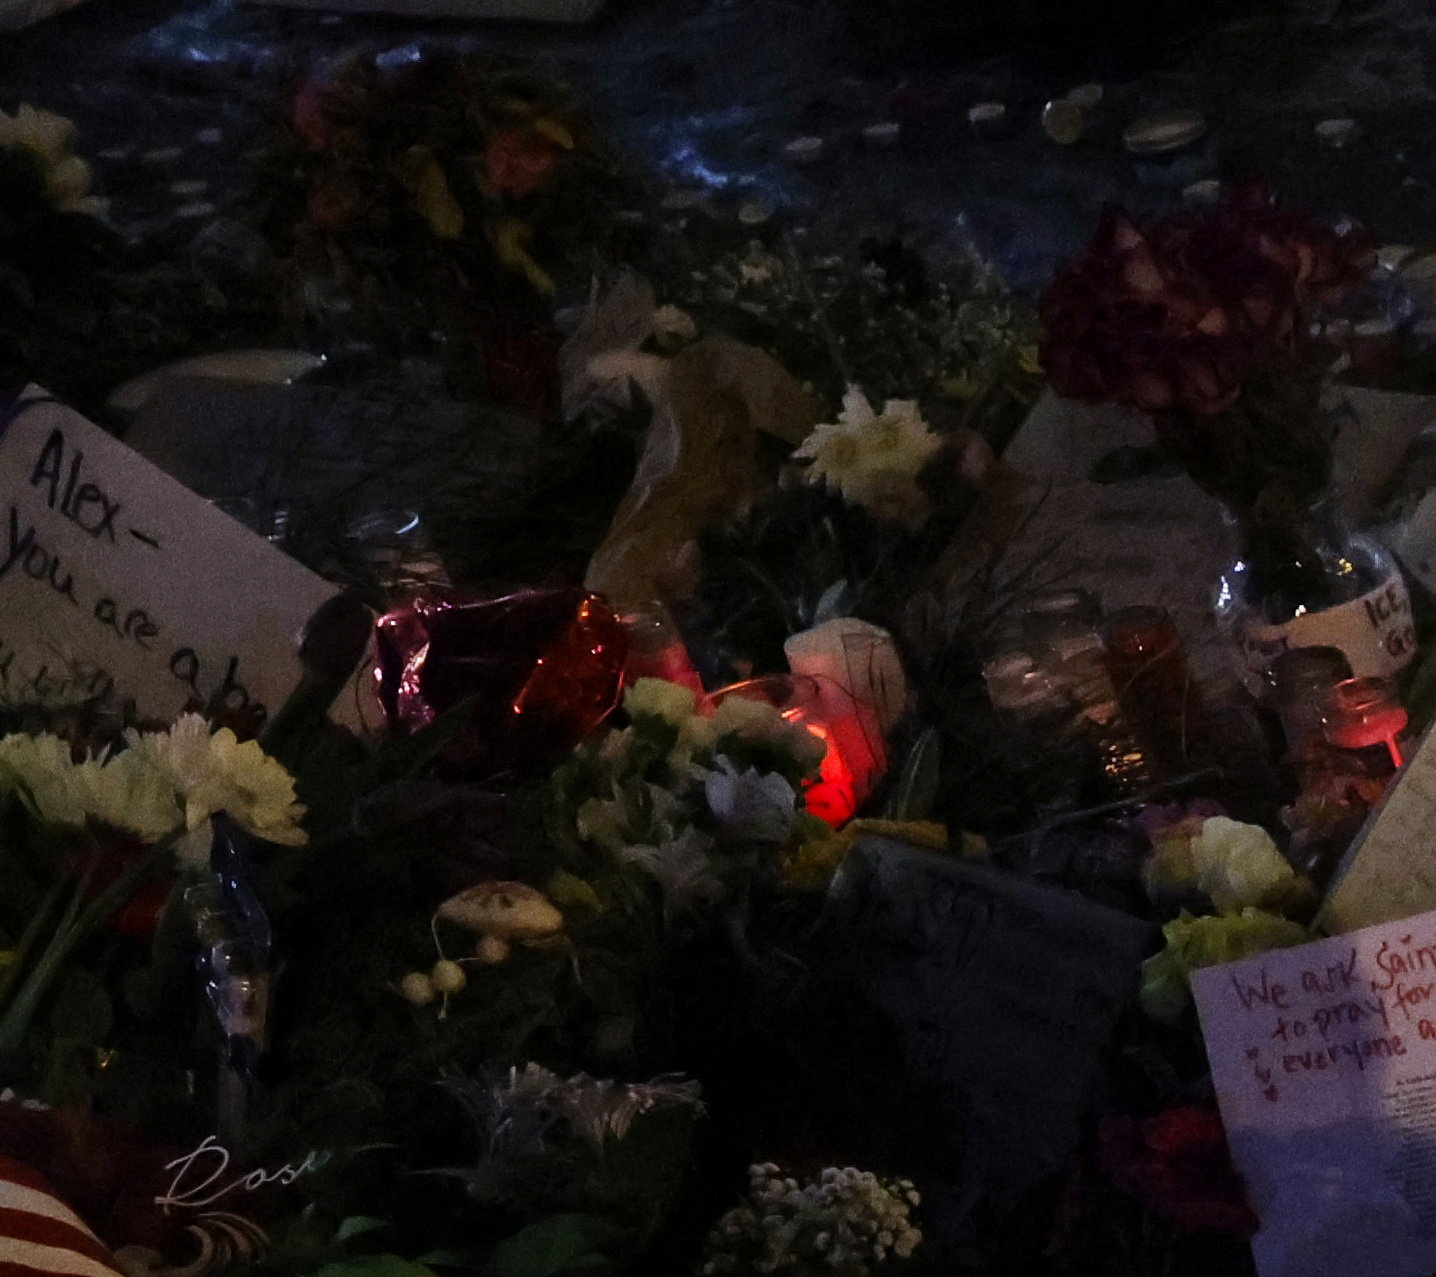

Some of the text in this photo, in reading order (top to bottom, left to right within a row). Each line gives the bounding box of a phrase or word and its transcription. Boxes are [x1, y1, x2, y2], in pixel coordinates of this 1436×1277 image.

[93, 597, 160, 649] are
[1230, 966, 1290, 1011] We
[1300, 947, 1360, 993] ask
[1270, 1016, 1306, 1042] to
[1313, 989, 1389, 1042] pray
